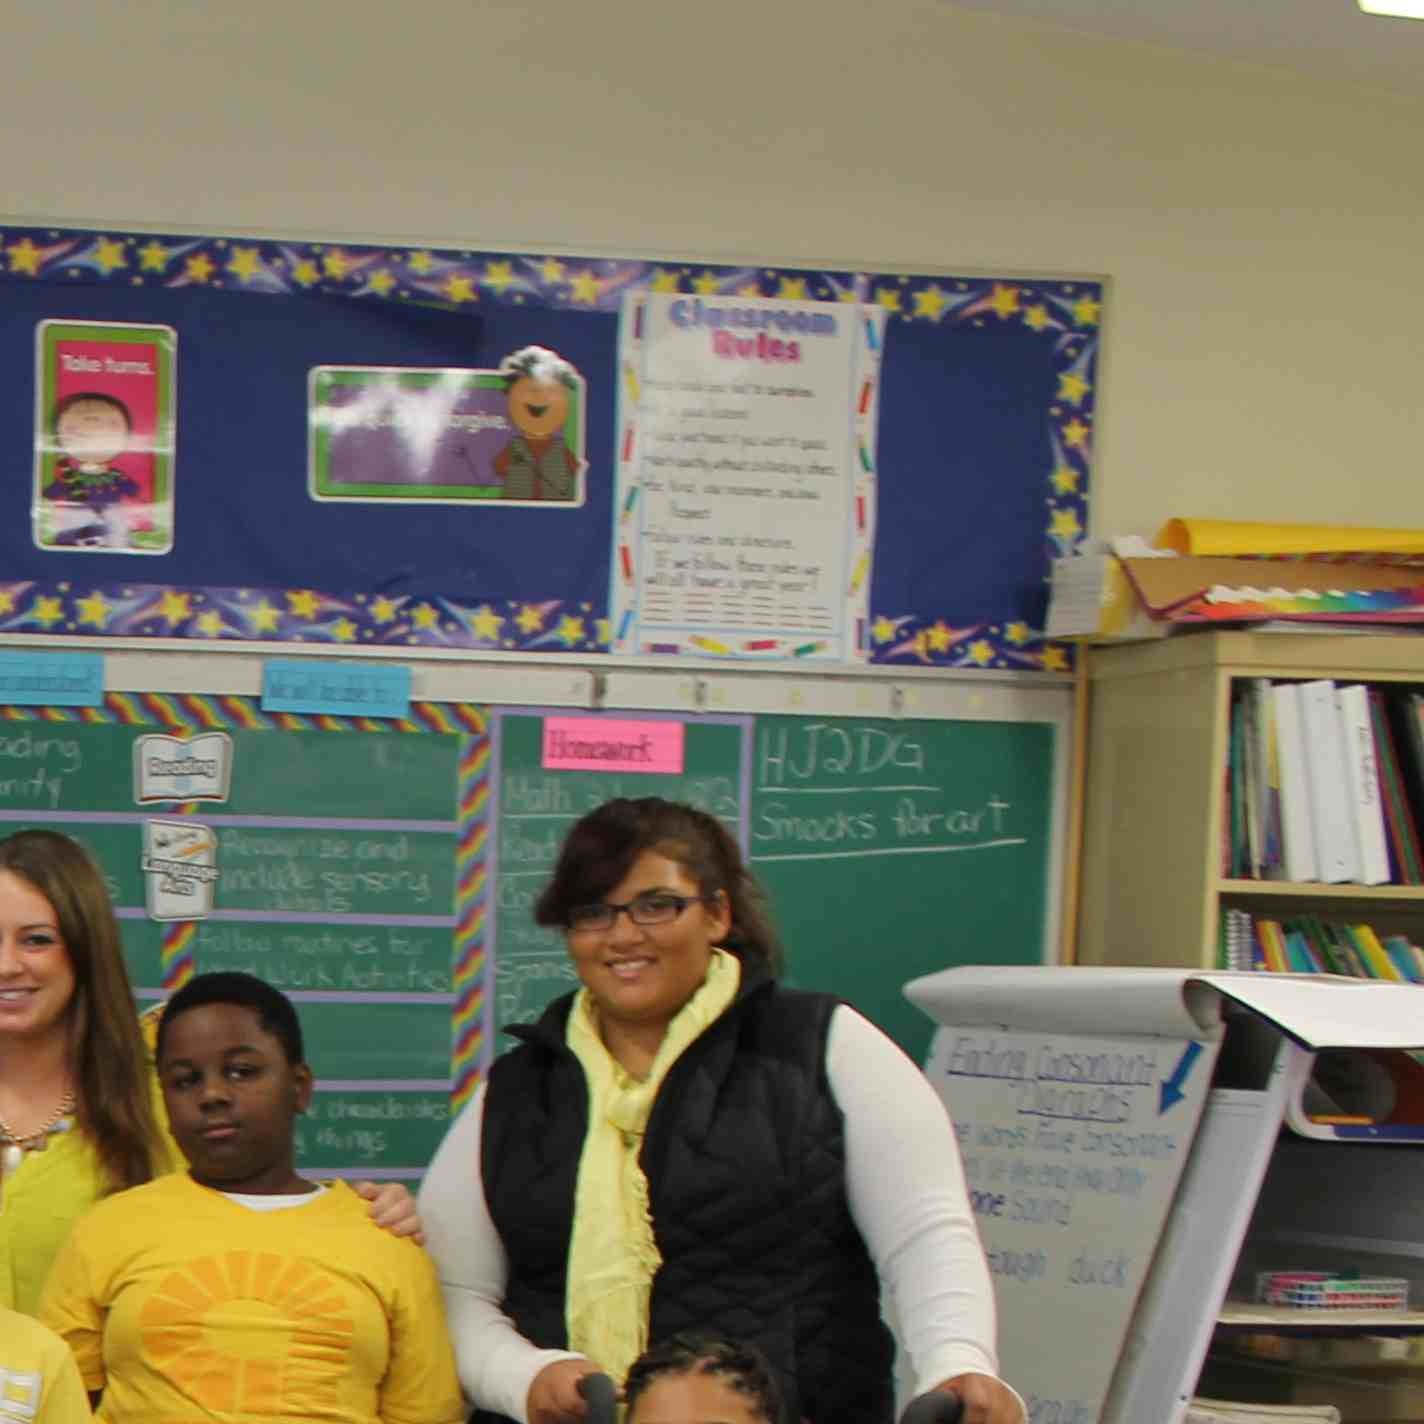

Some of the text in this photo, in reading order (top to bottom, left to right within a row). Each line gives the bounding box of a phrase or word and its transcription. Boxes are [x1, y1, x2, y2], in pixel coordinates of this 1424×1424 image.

[669, 297, 837, 337] Classroom
[712, 329, 801, 364] Rules
[61, 354, 156, 377] Take turns.
[548, 728, 655, 762] Homework
[753, 793, 1011, 841] Smocks for art
